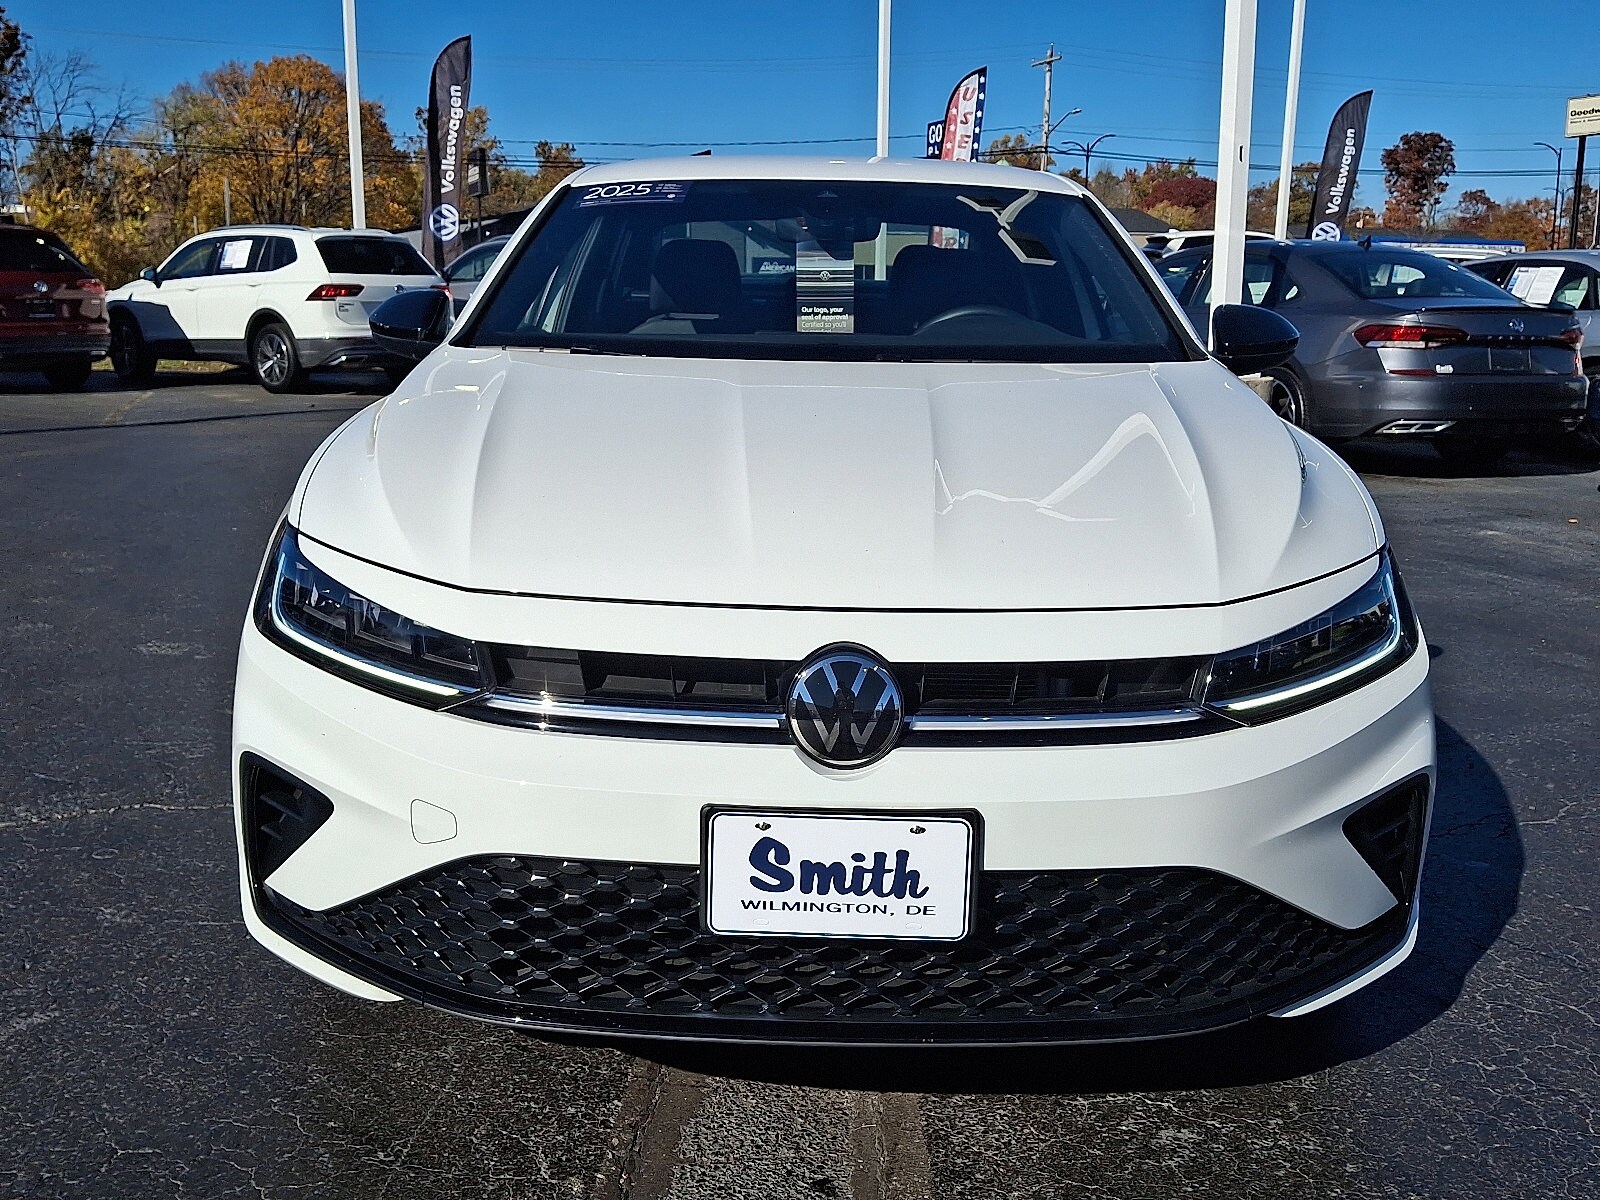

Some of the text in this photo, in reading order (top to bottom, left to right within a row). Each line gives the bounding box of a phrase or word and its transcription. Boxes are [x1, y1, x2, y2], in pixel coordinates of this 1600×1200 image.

[929, 124, 944, 143] GO
[956, 87, 976, 161] USE
[440, 85, 464, 194] Volkswagen
[928, 146, 940, 156] PL
[1325, 128, 1356, 214] Volkswagen
[583, 183, 653, 199] 2025
[814, 306, 829, 314] logo,
[748, 836, 930, 899] Smith
[741, 899, 937, 917] WILMINGTON, DE
